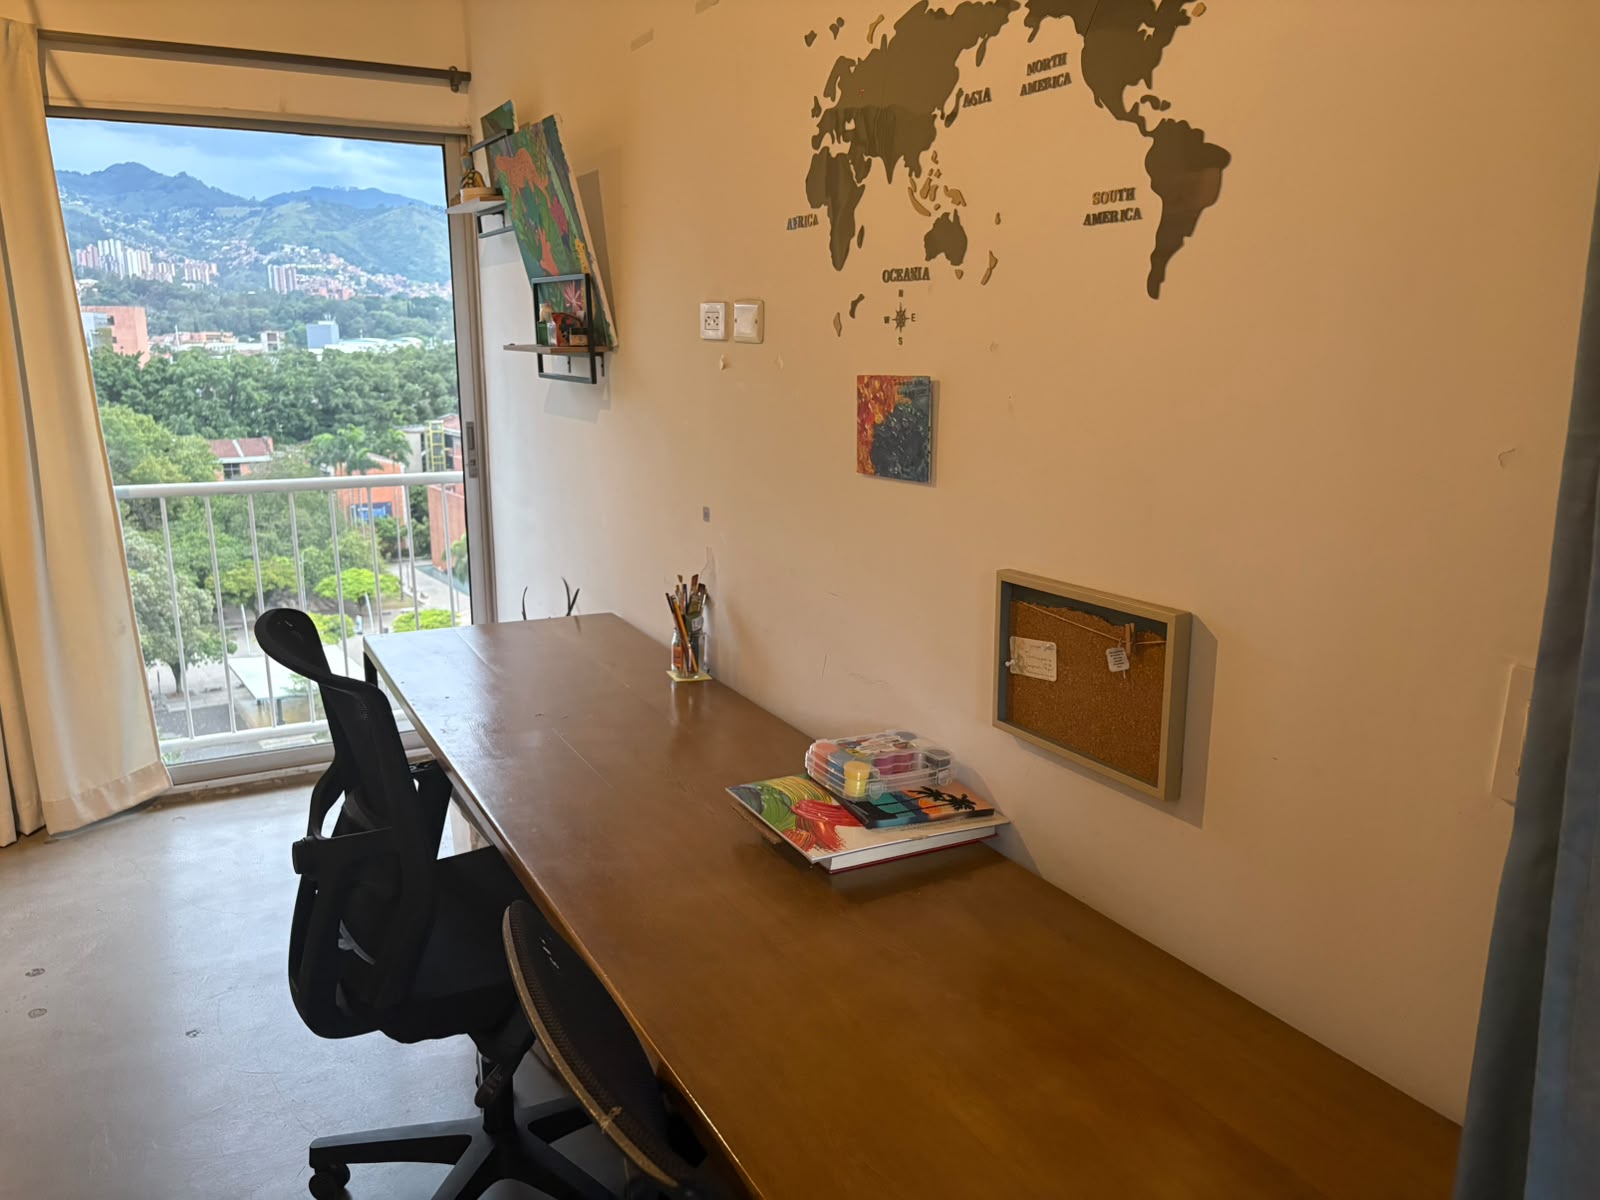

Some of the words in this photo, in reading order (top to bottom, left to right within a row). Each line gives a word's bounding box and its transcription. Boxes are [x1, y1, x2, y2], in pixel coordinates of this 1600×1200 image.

[1026, 52, 1067, 76] NORTH
[1020, 72, 1072, 97] AMERICA
[962, 87, 992, 108] ASIA
[1092, 187, 1136, 205] SOUTH
[787, 213, 819, 231] AFRICA
[1083, 207, 1142, 226] AMERICA
[882, 267, 930, 283] OCEANIA
[898, 289, 904, 298] N
[884, 315, 891, 324] W
[911, 313, 917, 323] E
[898, 336, 904, 346] S
